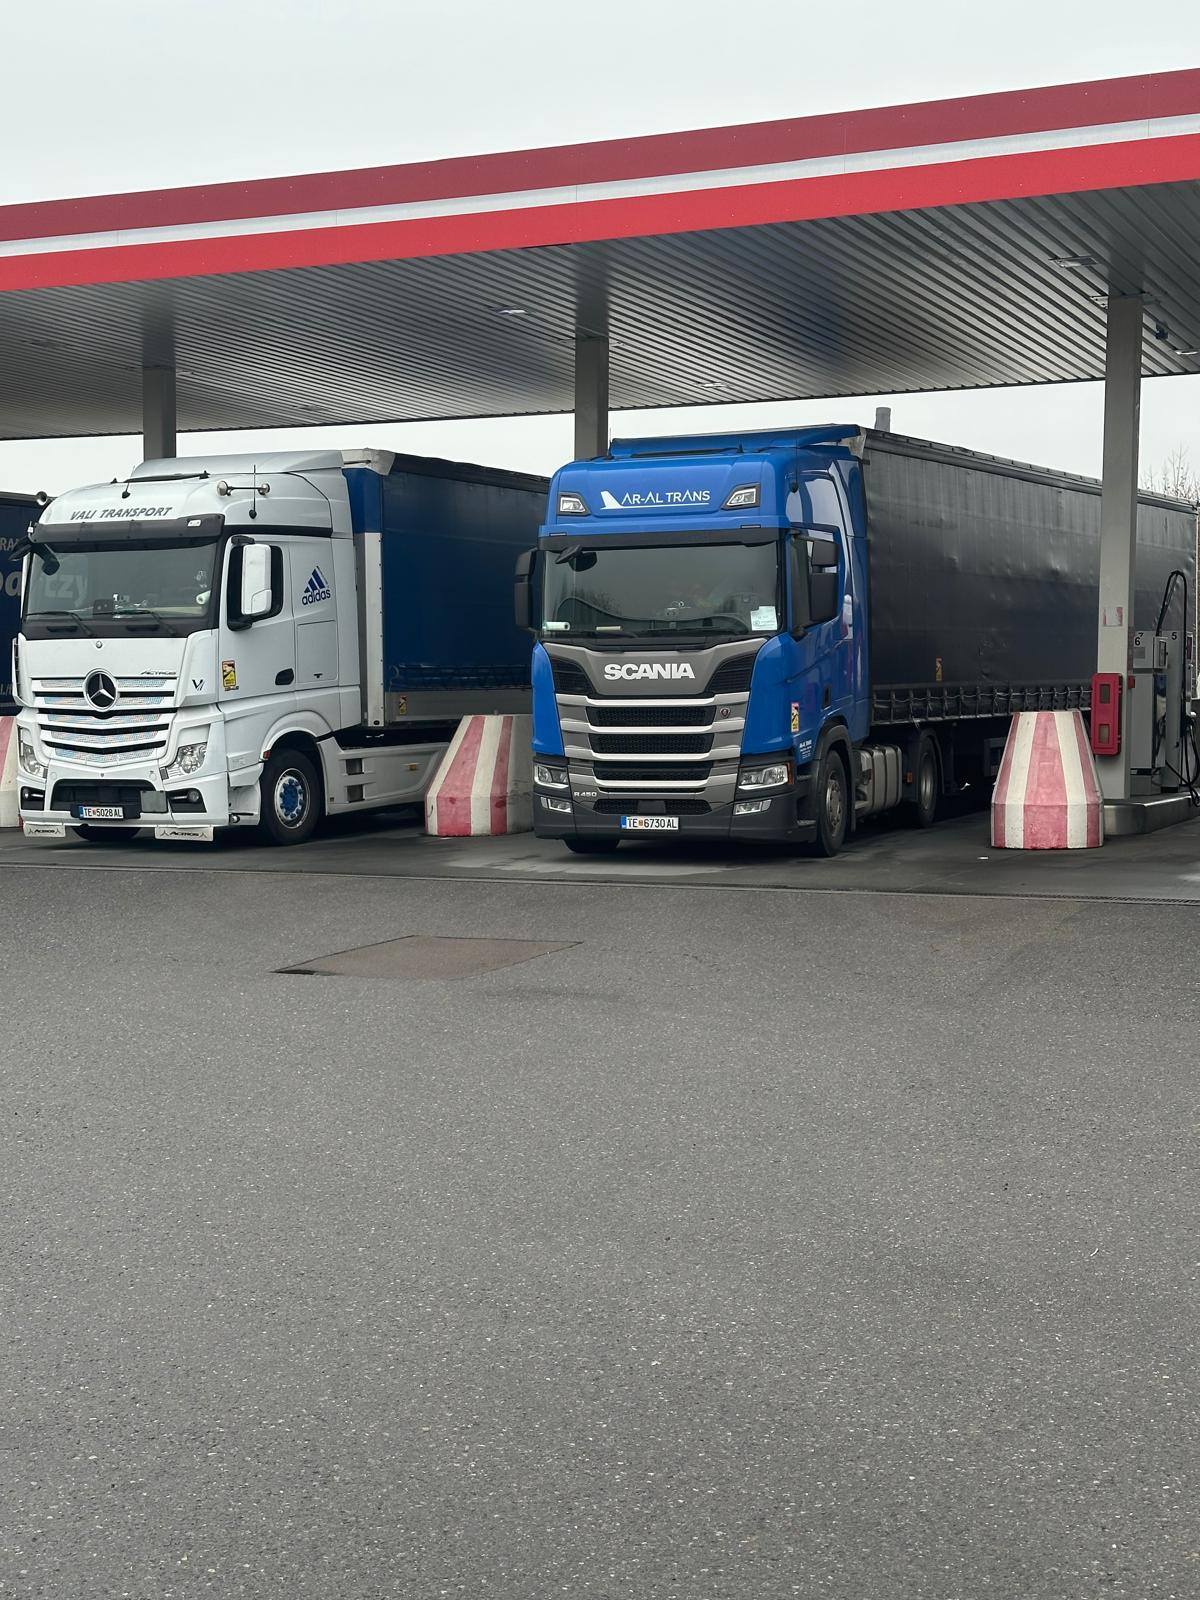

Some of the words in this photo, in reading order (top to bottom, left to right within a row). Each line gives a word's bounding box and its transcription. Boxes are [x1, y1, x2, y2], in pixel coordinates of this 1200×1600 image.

[621, 491, 663, 505] AR-AL
[665, 489, 710, 503] TRANS
[70, 509, 97, 521] VALI
[99, 506, 173, 519] TRANSPORT
[302, 589, 330, 605] adidas
[1134, 637, 1140, 646] 6
[1171, 632, 1178, 640] 5
[604, 663, 696, 680] SCANIA
